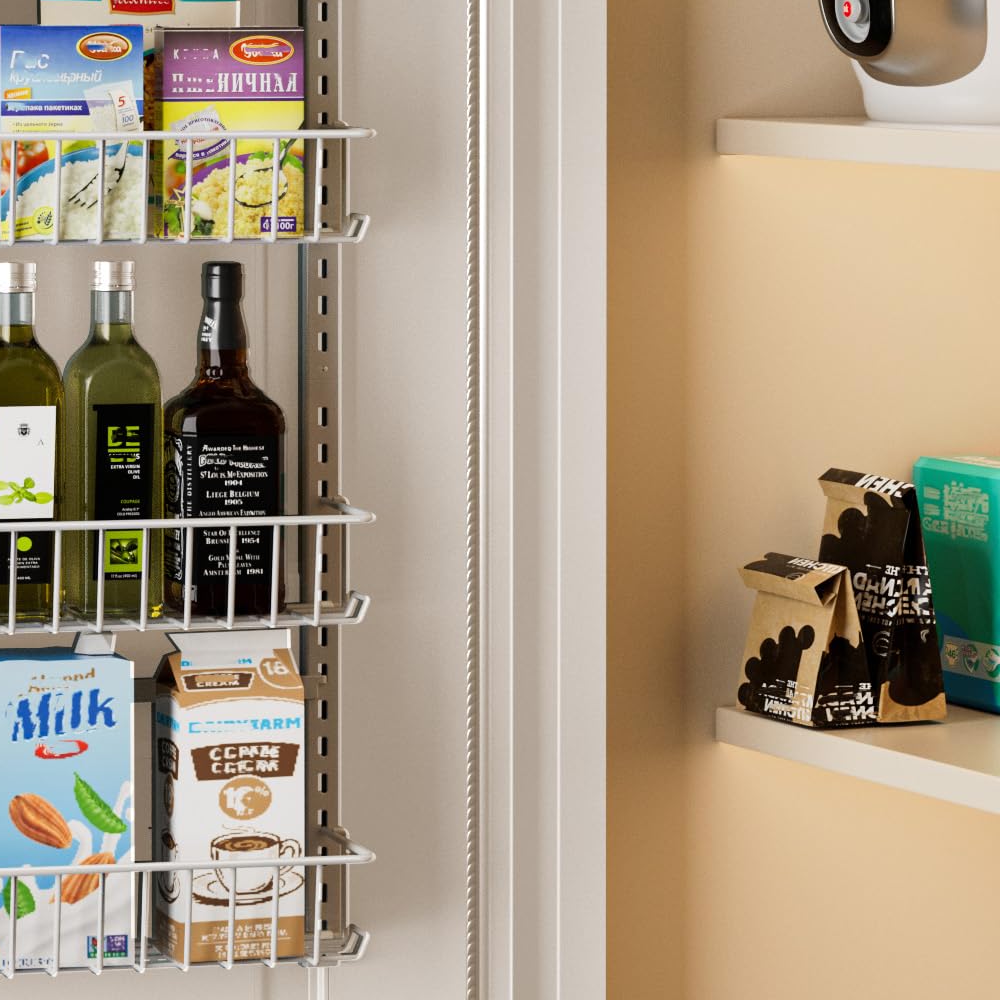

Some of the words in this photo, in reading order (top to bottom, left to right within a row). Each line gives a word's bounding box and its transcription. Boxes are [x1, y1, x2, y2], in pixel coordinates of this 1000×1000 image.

[118, 96, 126, 107] 5
[122, 114, 134, 123] 100
[206, 490, 228, 498] LIEGE
[230, 490, 260, 498] BELGIUM
